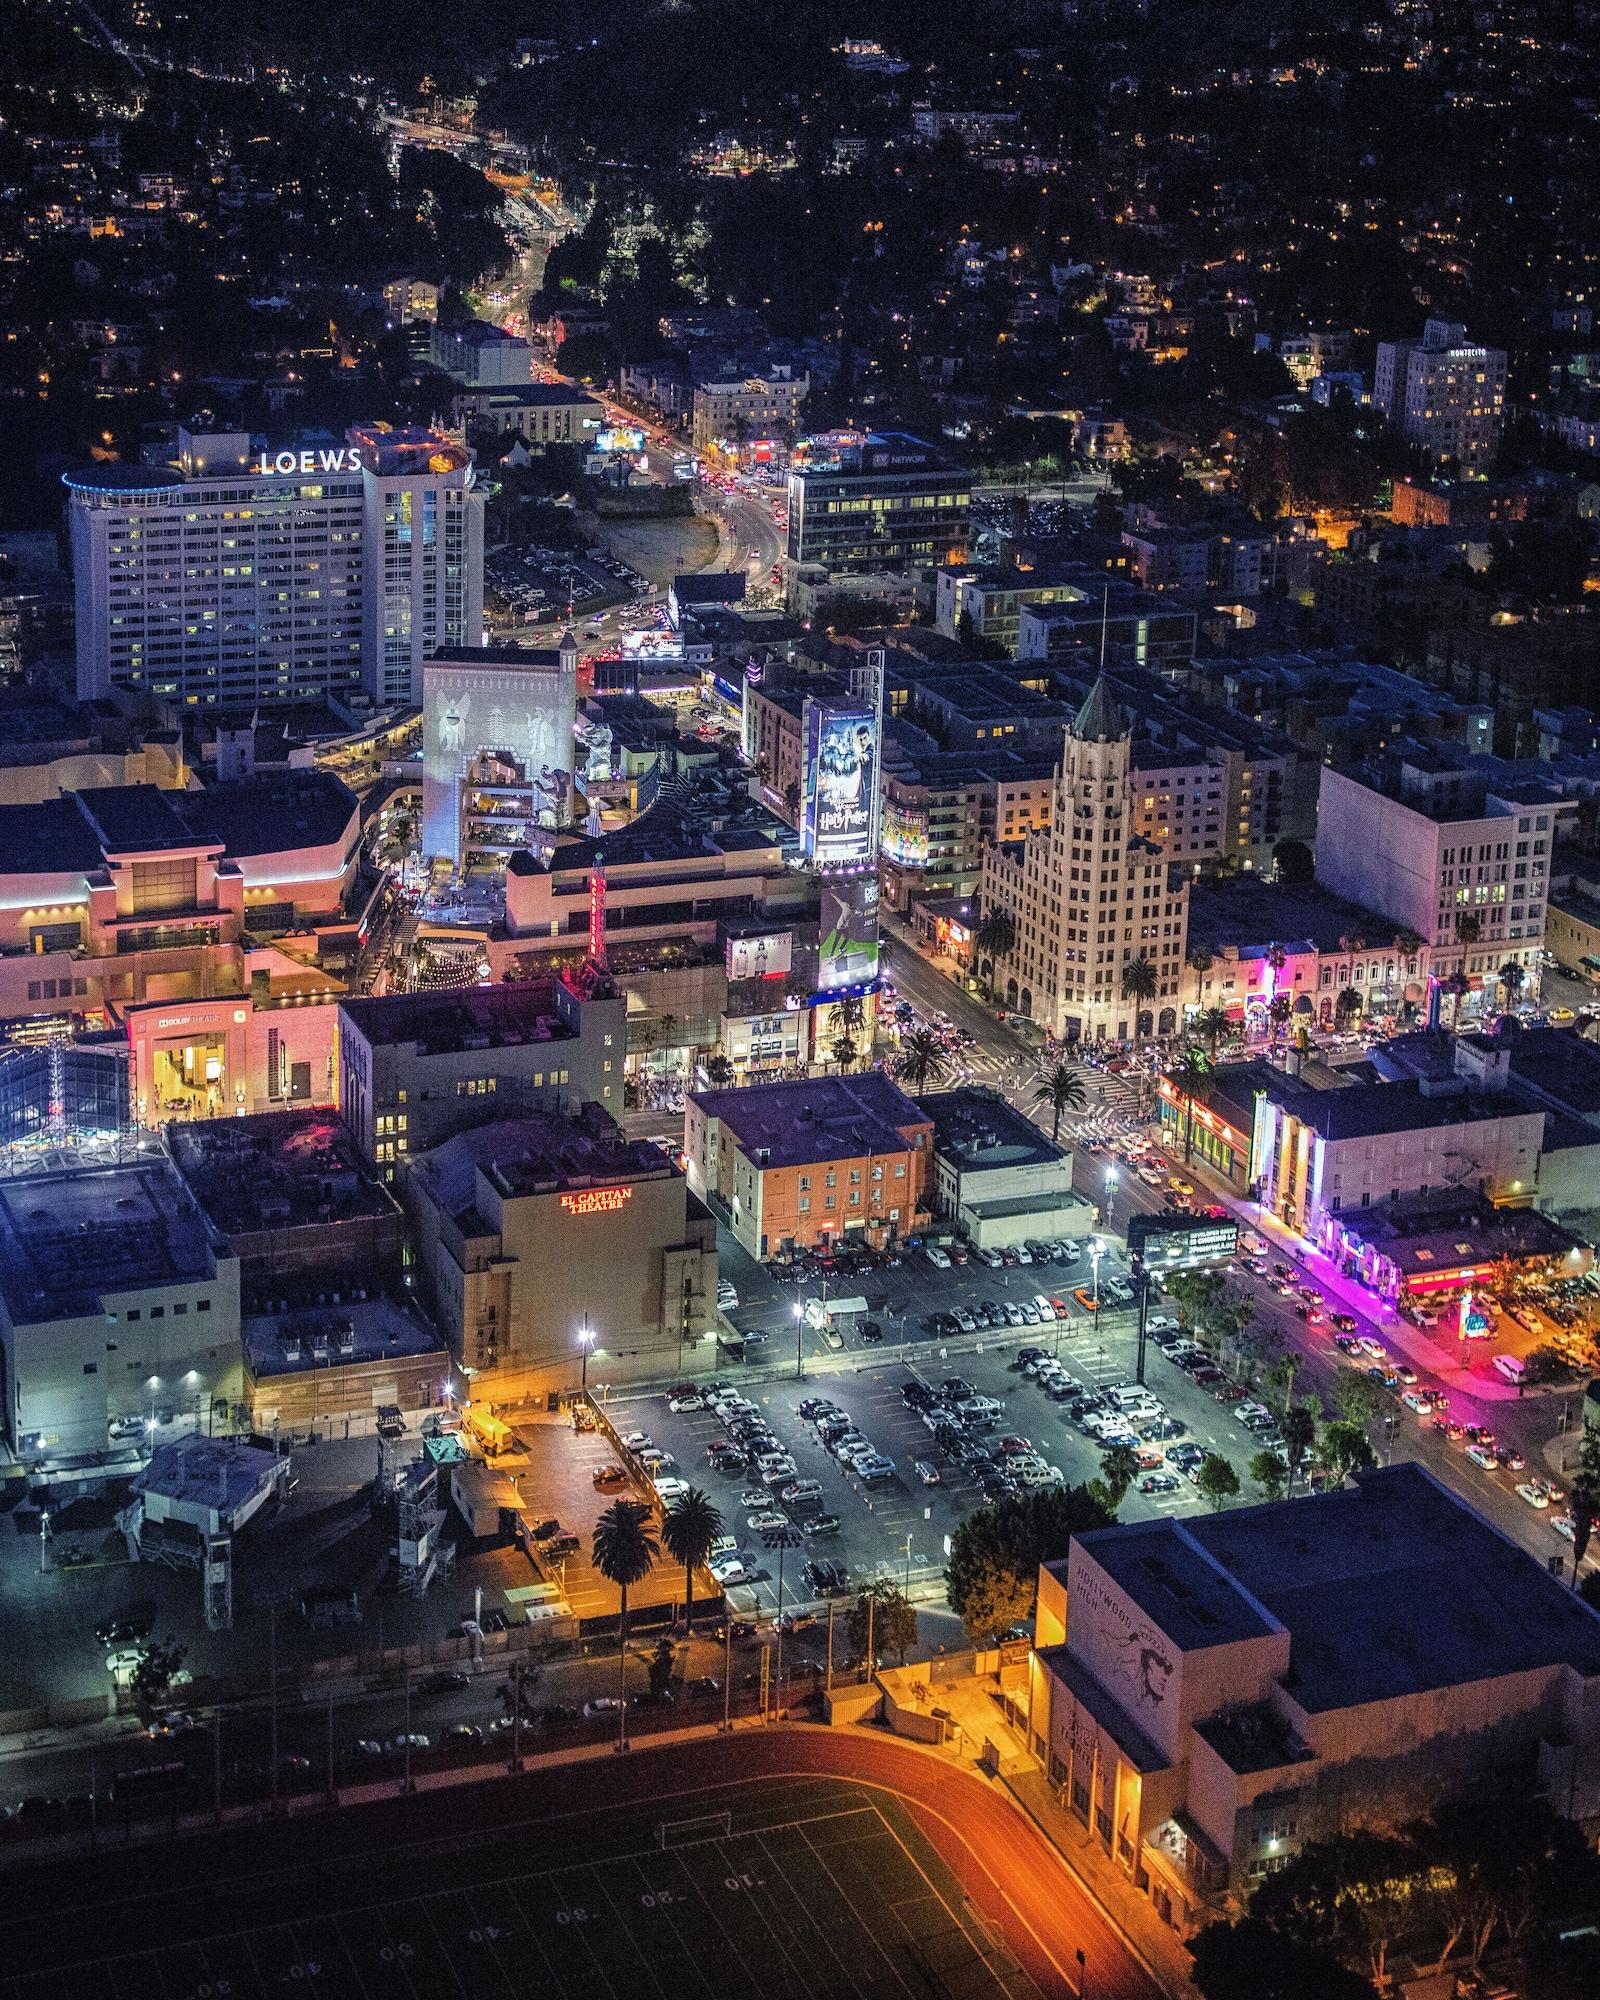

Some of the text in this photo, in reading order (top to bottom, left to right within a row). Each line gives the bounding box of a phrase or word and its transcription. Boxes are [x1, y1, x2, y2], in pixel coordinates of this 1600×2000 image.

[1450, 349, 1486, 357] MONTECITO
[261, 448, 361, 475] LOEWS
[891, 455, 926, 464] NETWORK
[819, 811, 845, 830] Harry
[843, 808, 869, 833] Potter
[169, 1016, 190, 1025] DOLBY
[561, 1188, 632, 1206] EL CAPITAN
[570, 1199, 624, 1214] THEATRE
[1190, 1231, 1219, 1239] DEVELOPER
[1198, 1235, 1226, 1244] CHOKING
[1227, 1232, 1236, 1240] LA
[1077, 1583, 1098, 1611] HIGH
[1077, 1567, 1132, 1629] HOLLYWOOD
